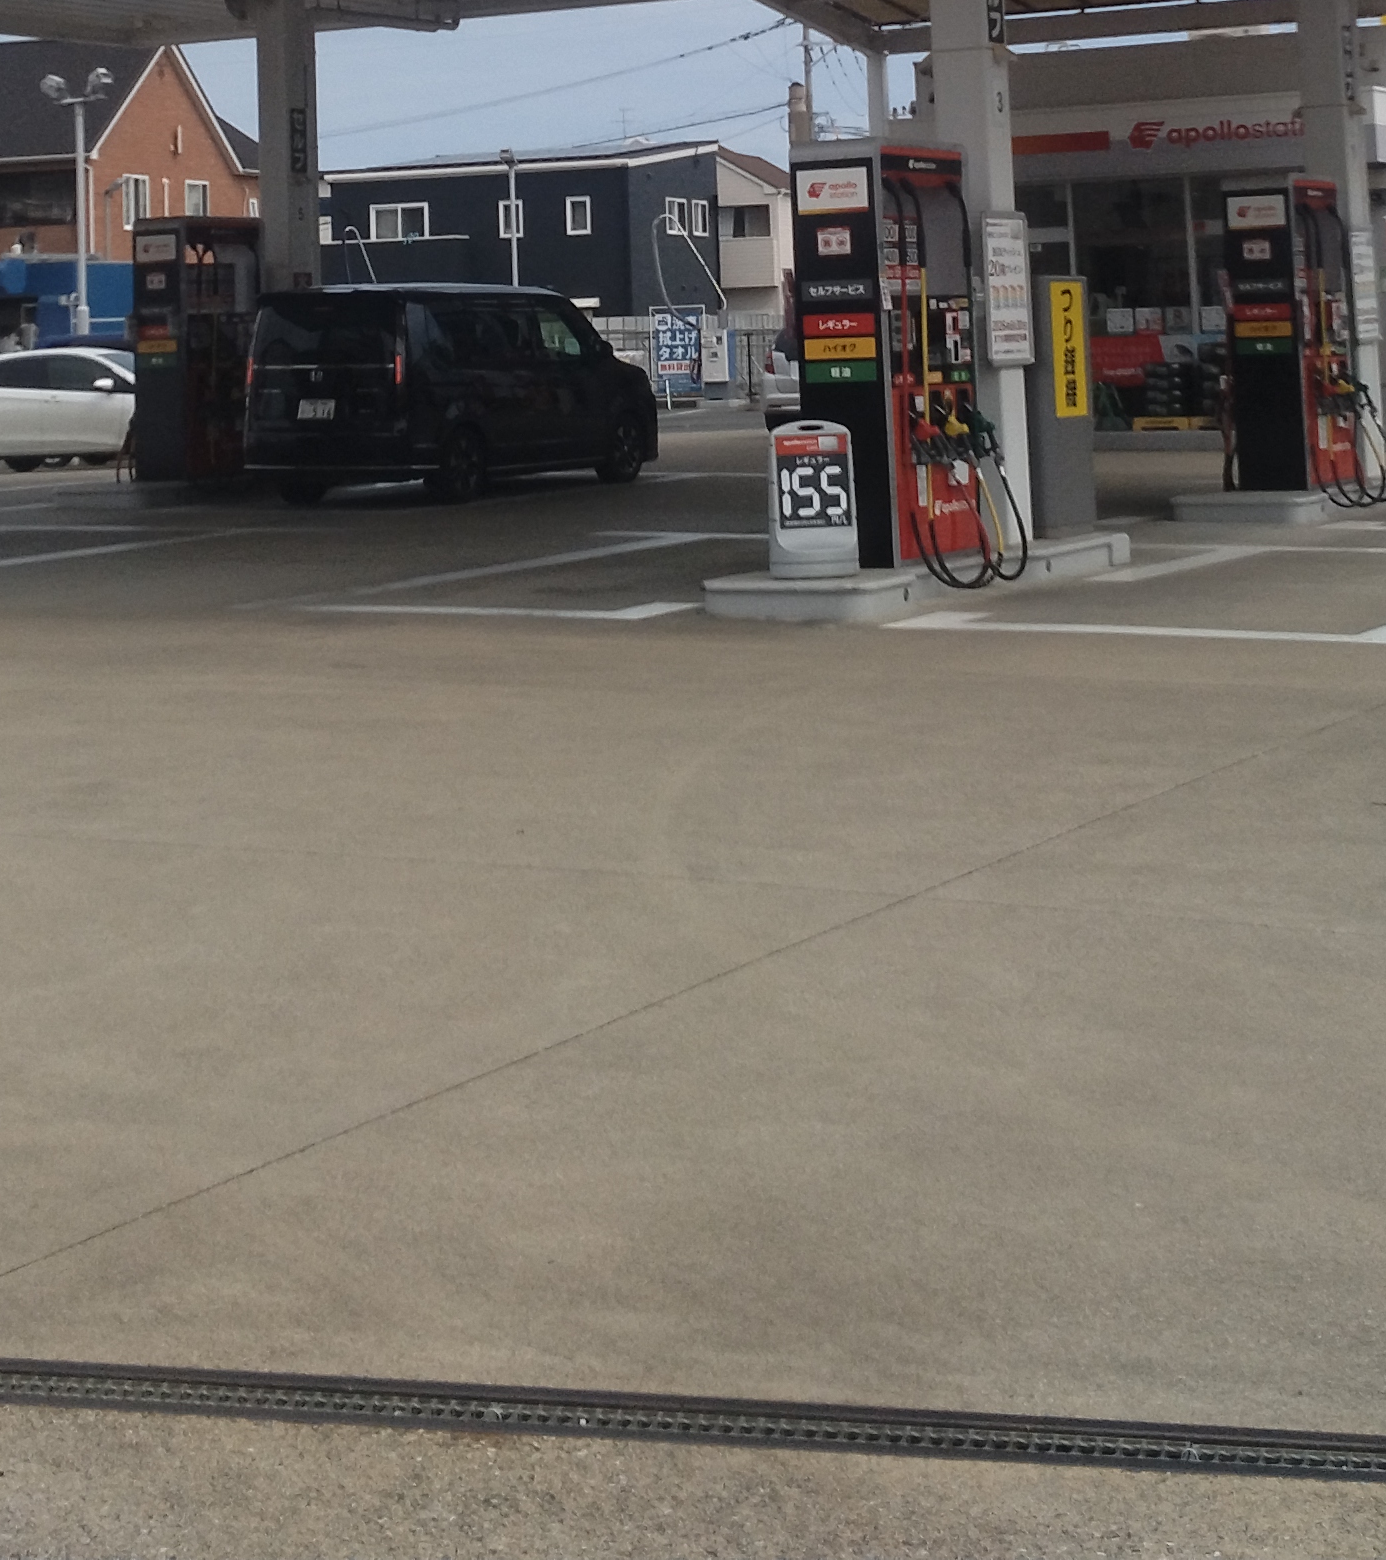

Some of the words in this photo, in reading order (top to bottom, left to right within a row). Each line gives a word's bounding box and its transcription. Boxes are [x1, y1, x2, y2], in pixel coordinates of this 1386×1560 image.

[809, 284, 864, 296] セルフサービス
[819, 320, 857, 330] レギュラー
[659, 346, 698, 361] タオル
[823, 343, 856, 353] ハイオク
[781, 465, 847, 518] 155
